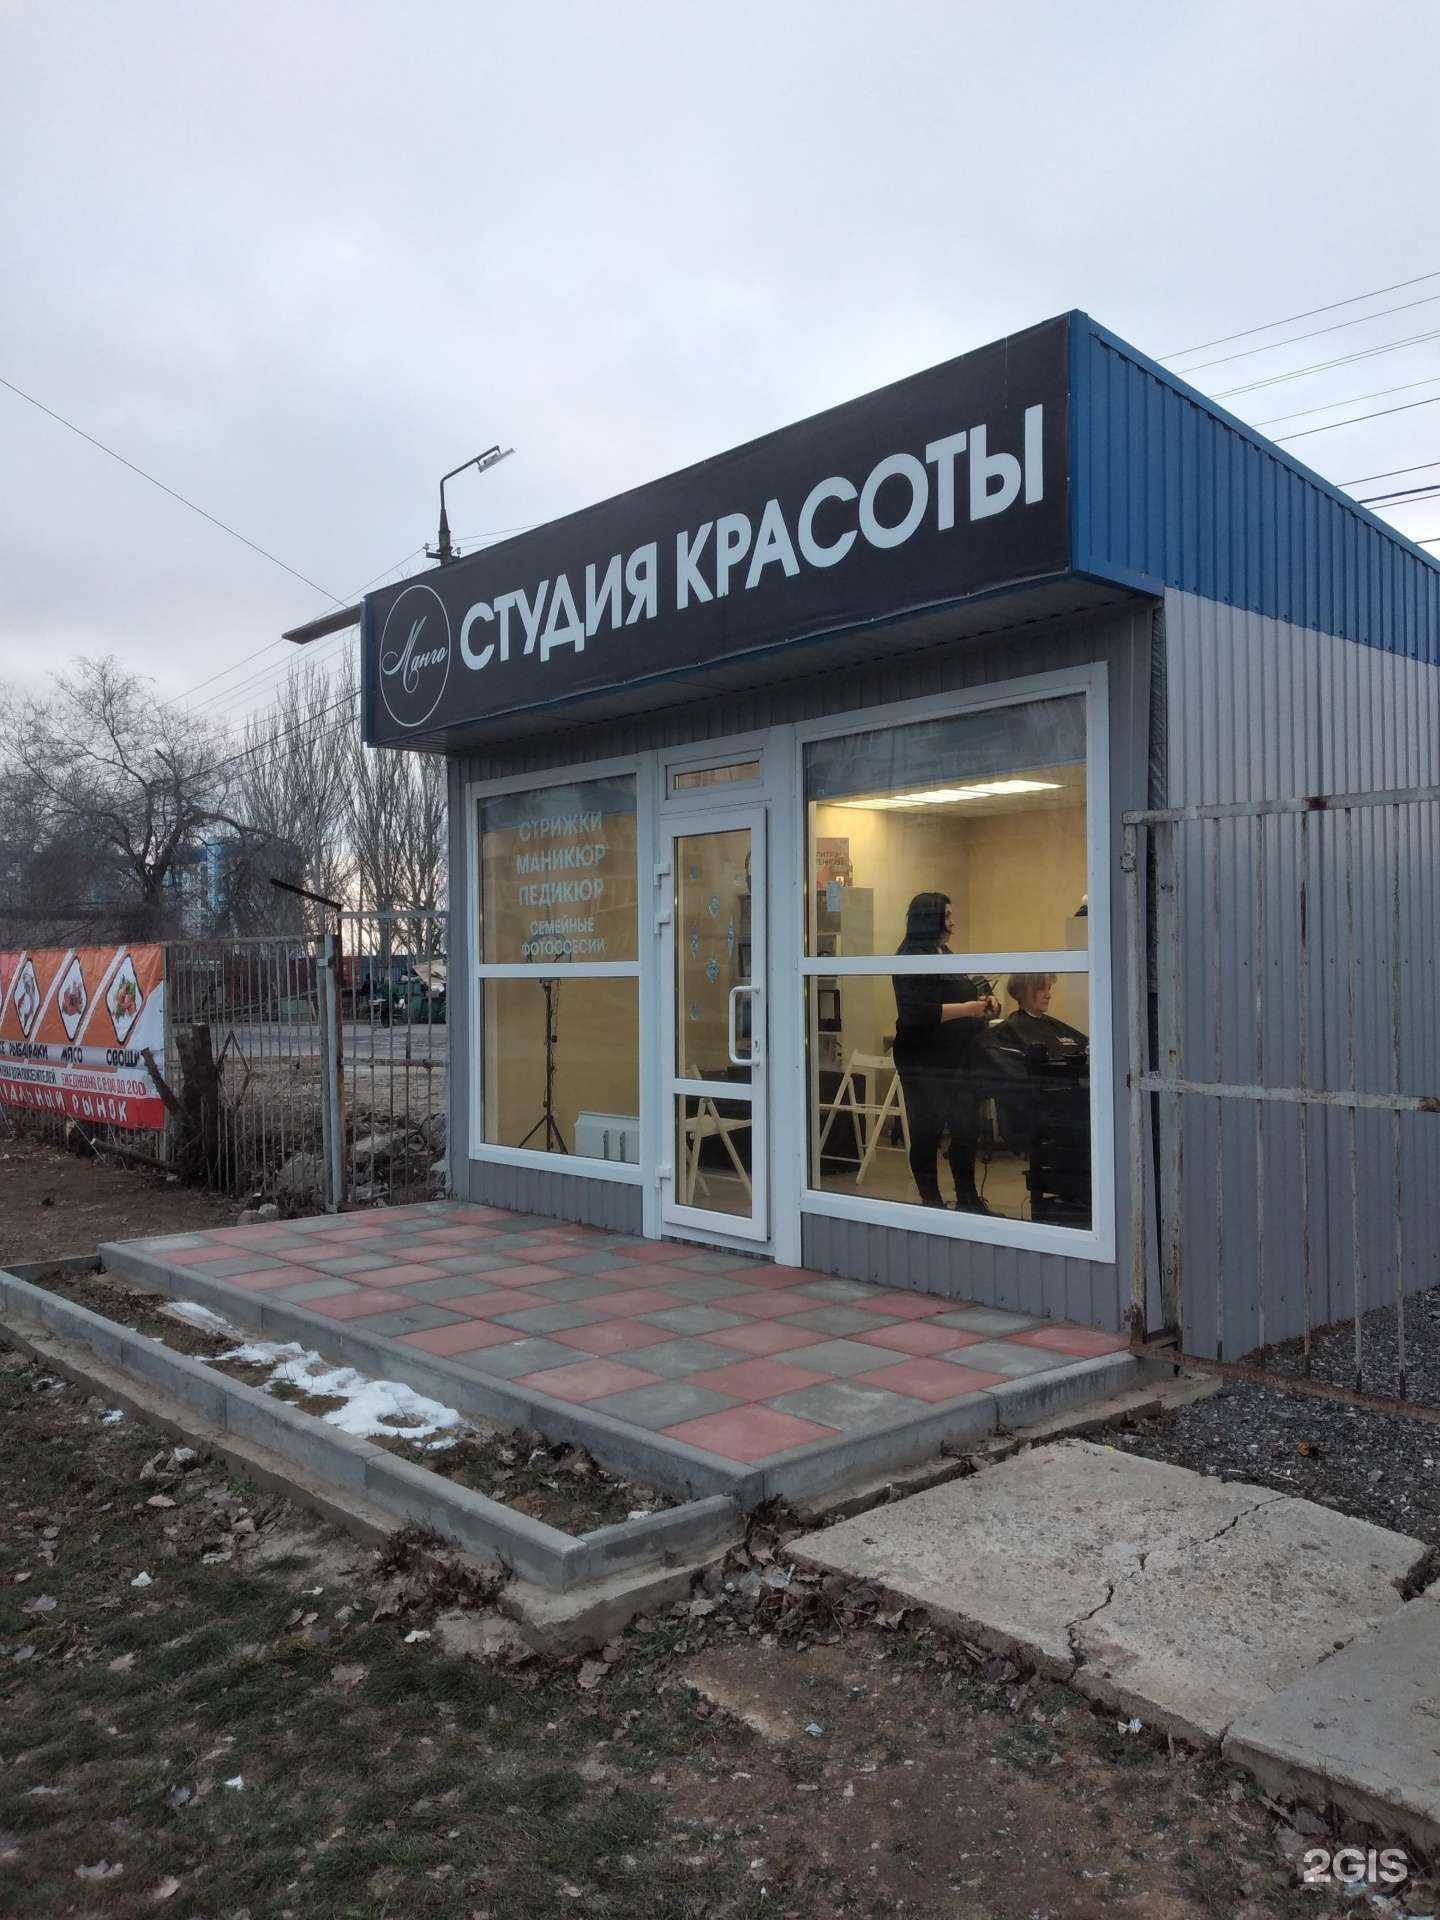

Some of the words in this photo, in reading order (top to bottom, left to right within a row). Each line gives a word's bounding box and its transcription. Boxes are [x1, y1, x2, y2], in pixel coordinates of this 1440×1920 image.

[459, 541, 658, 671] СТУДИЯ
[675, 403, 1044, 611] КРАСОТЫ
[381, 615, 449, 694] Манго
[519, 811, 603, 842] СТРИЖКИ
[516, 843, 608, 875] МАНИКЮР
[518, 878, 605, 907] ПЕДИКЮР
[529, 913, 595, 936] СЕМЕЙНЫЕ
[61, 1046, 84, 1064] МЯСО
[71, 1093, 128, 1122] РЫНОК
